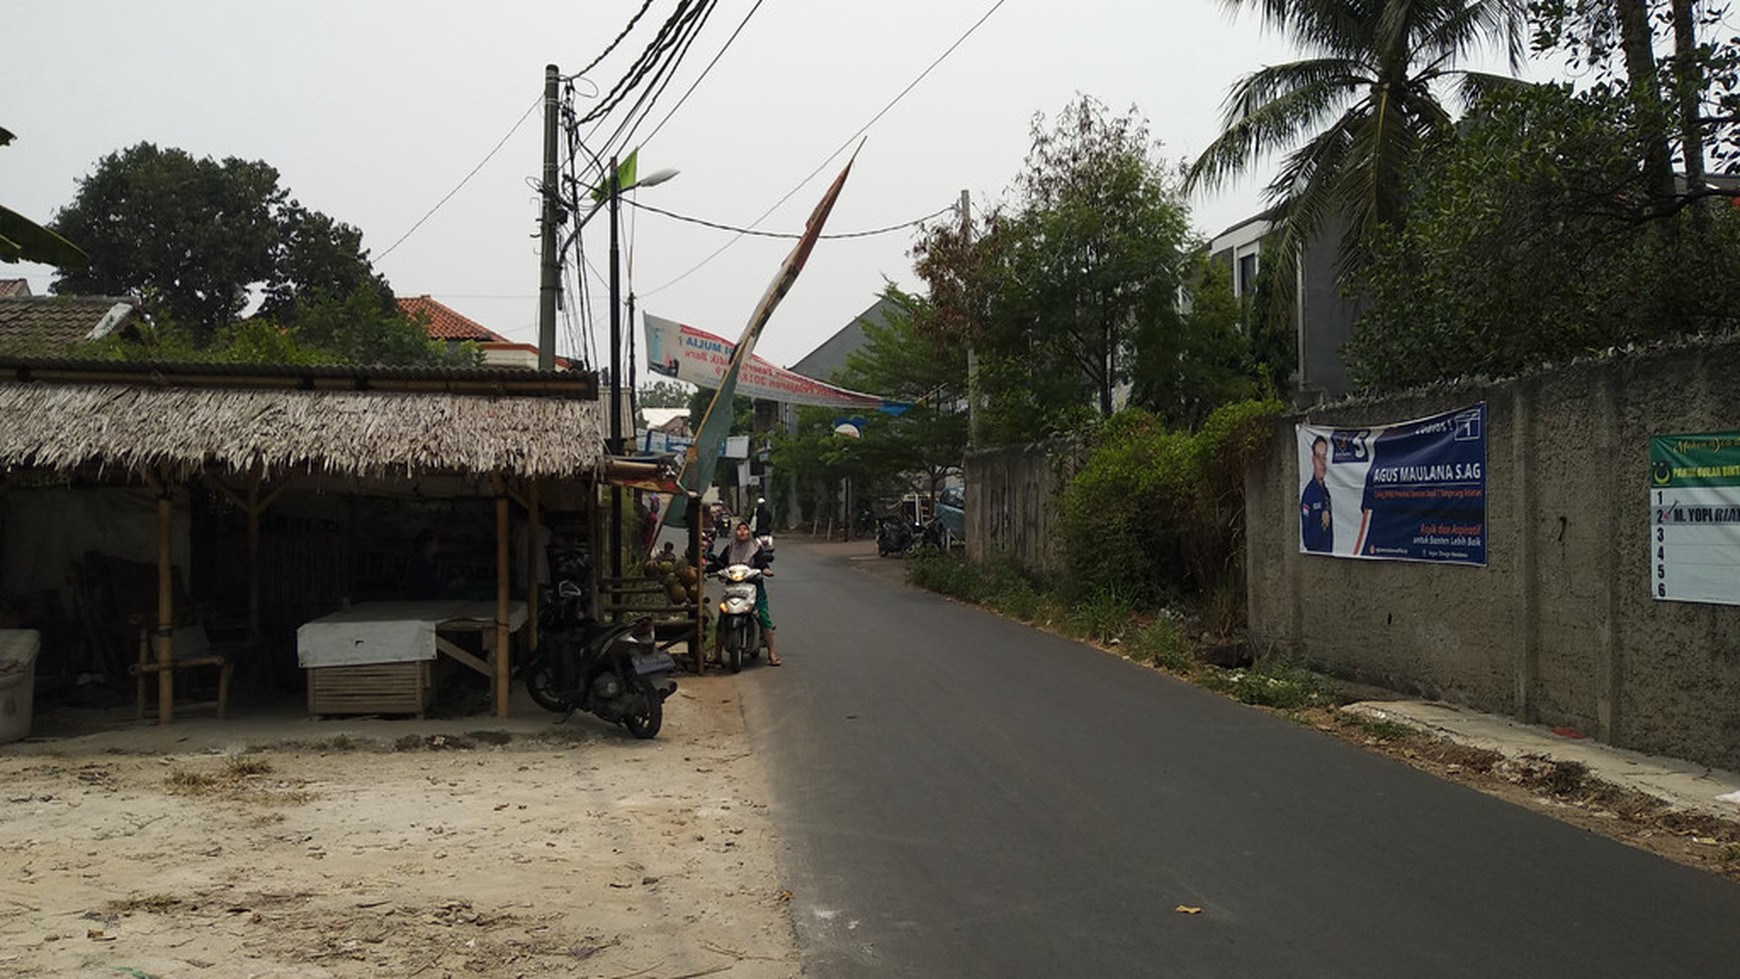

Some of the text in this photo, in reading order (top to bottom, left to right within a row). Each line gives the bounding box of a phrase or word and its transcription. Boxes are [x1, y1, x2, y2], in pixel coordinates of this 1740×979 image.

[1464, 420, 1472, 437] 1
[1352, 430, 1369, 459] 5
[1374, 462, 1481, 483] AGUS MAULANA S.AG
[1657, 490, 1663, 505] 1
[1657, 508, 1664, 524] 2
[1429, 535, 1450, 545] Banten
[1450, 537, 1467, 546] Lebih
[1467, 536, 1481, 547] Baik
[1656, 527, 1665, 542] 3
[1657, 545, 1665, 560] 4
[1657, 563, 1665, 579] 5
[1657, 582, 1666, 598] 6
